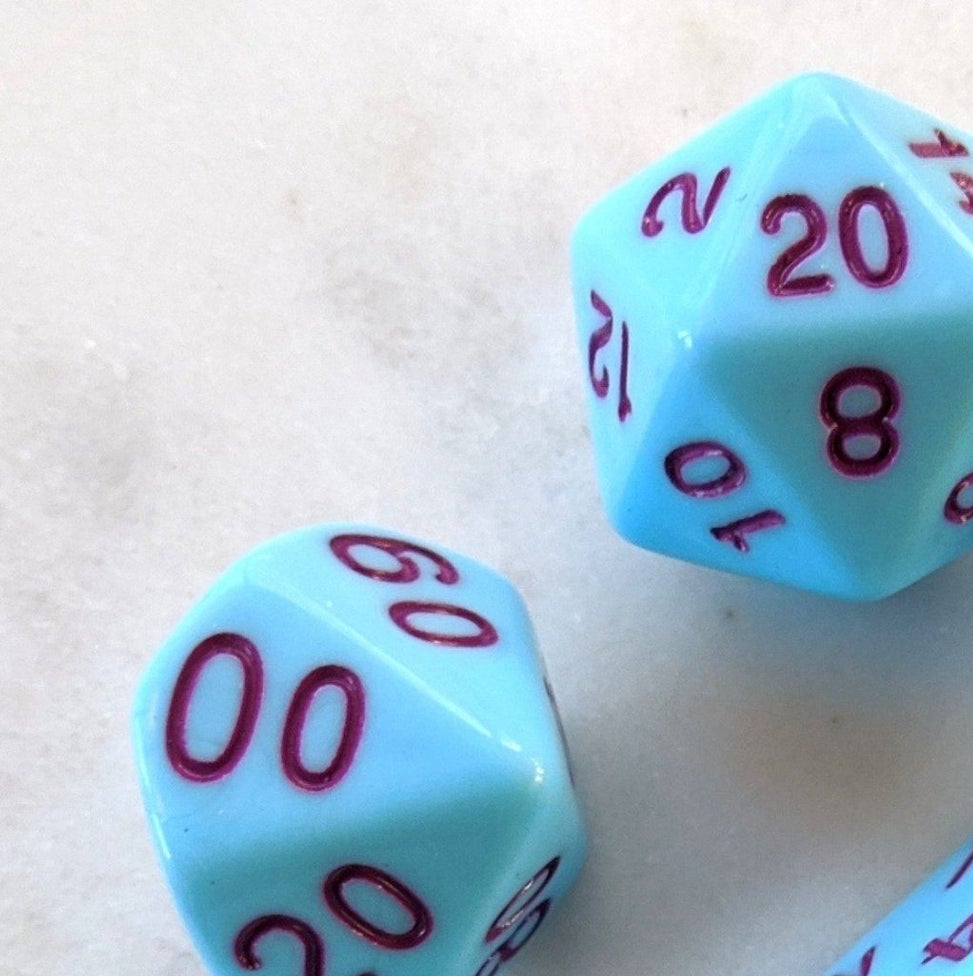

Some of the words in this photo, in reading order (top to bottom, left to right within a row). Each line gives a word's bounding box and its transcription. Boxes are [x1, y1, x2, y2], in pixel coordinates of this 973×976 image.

[641, 166, 731, 239] 2
[759, 185, 910, 299] 20
[818, 366, 902, 480] 8
[664, 440, 787, 553] 10
[164, 631, 367, 793] 00
